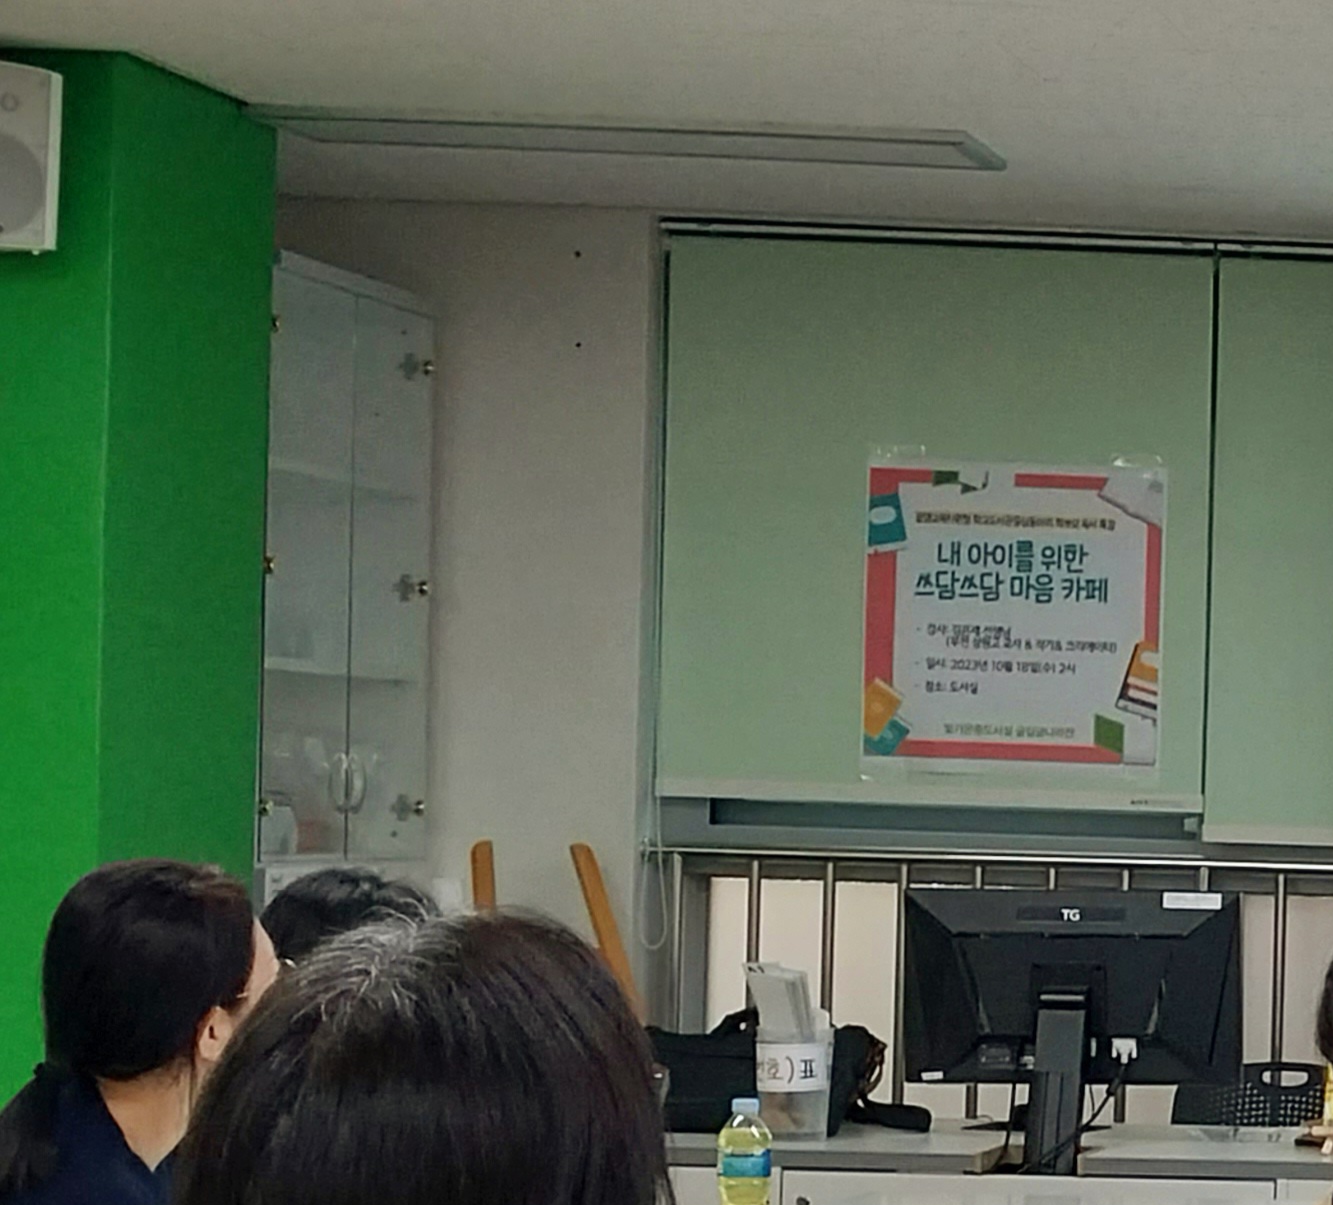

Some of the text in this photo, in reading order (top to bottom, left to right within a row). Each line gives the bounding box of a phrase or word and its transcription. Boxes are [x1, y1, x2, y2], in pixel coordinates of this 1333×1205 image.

[937, 540, 1090, 574] 내 아이를 위한
[914, 570, 1110, 604] 쓰담쓰담 마음 카페
[950, 658, 989, 673] 2023년
[991, 660, 1013, 673] 10월
[1058, 662, 1076, 675] 2시
[1060, 908, 1082, 921] TG
